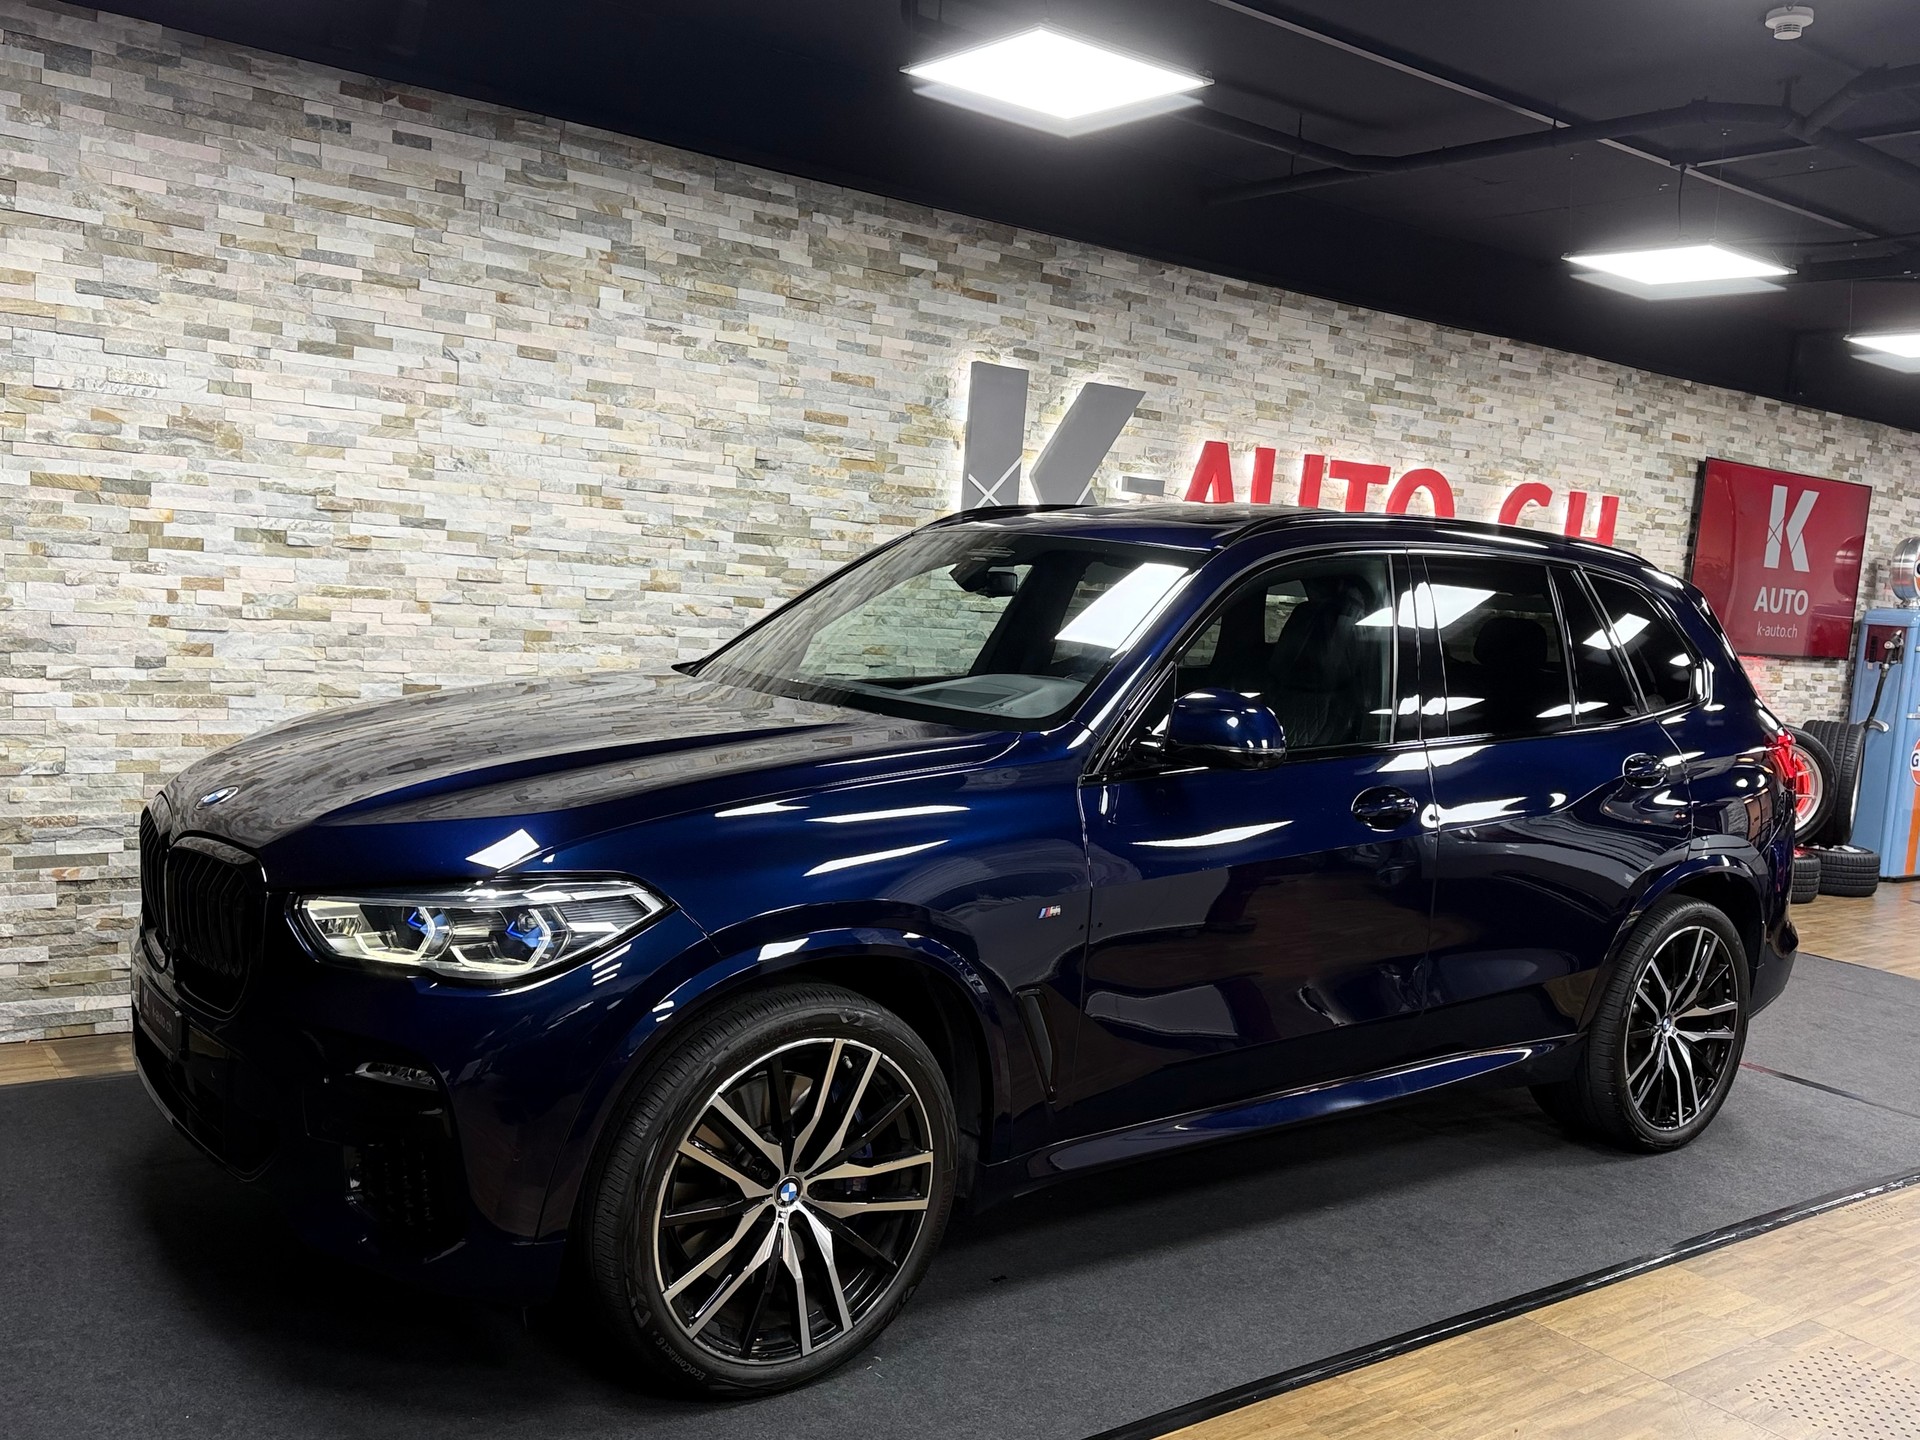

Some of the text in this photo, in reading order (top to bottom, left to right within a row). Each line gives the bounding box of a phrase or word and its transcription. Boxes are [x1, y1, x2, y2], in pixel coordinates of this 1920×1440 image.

[1763, 484, 1820, 573] K
[1753, 586, 1809, 616] AUTO
[1756, 621, 1798, 639] k-auto.ch
[661, 1343, 706, 1381] EcoContact
